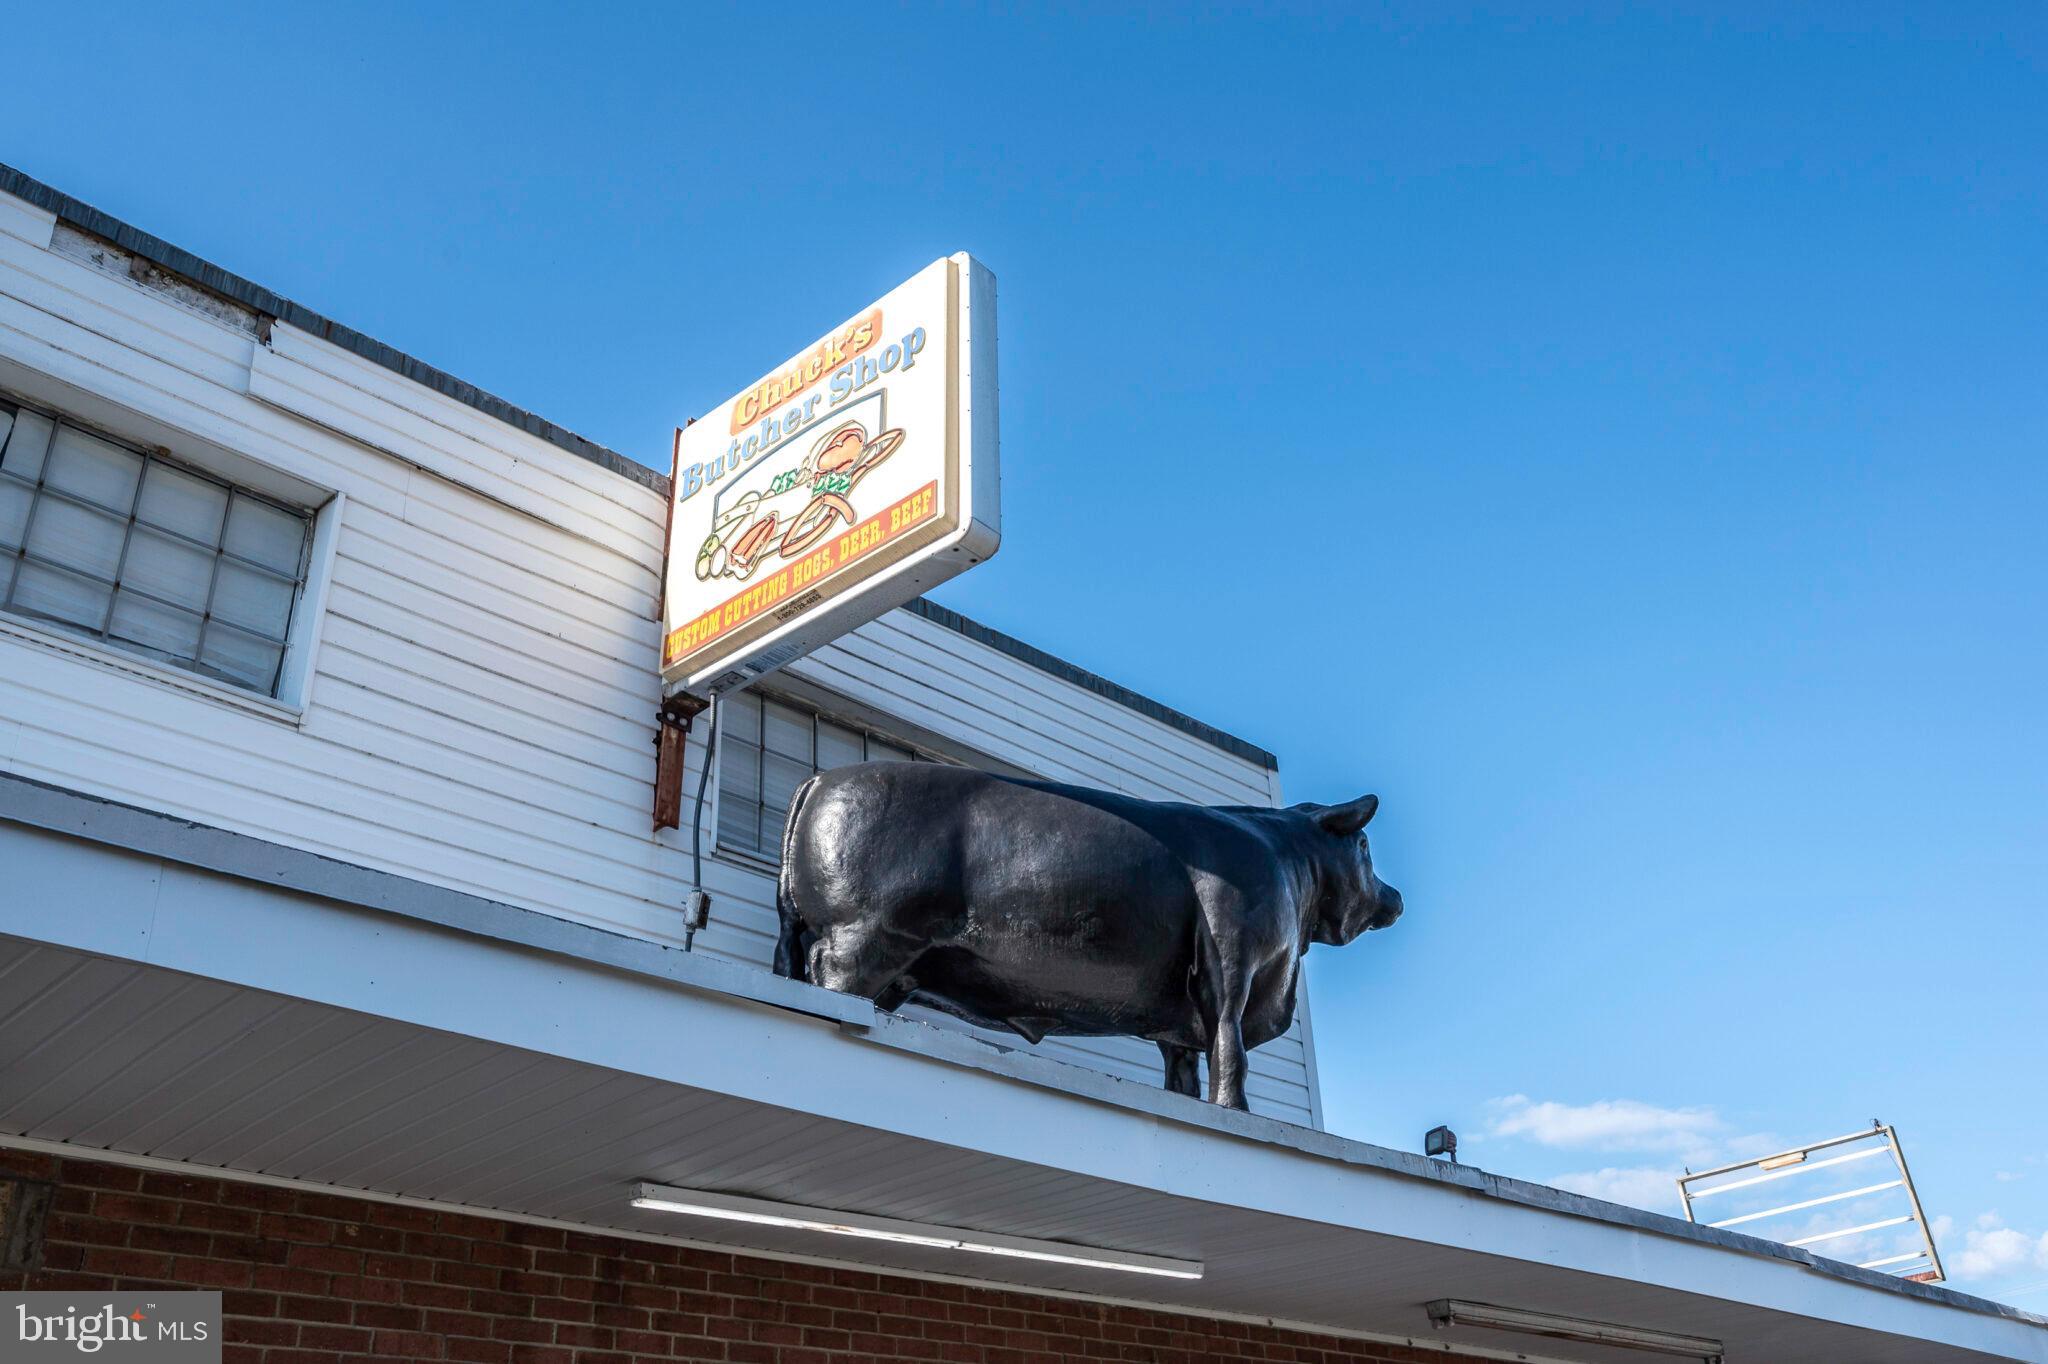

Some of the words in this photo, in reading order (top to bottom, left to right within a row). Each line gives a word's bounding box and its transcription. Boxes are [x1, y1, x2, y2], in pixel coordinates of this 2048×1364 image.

[680, 393, 822, 503] Butcher
[829, 326, 926, 407] Shop
[735, 321, 874, 427] Chuck's
[666, 608, 721, 658] CUSTOM
[724, 571, 788, 626] CUTTING
[792, 547, 834, 590] HOGS,
[839, 519, 886, 561] DEER,
[890, 488, 932, 532] BEEF
